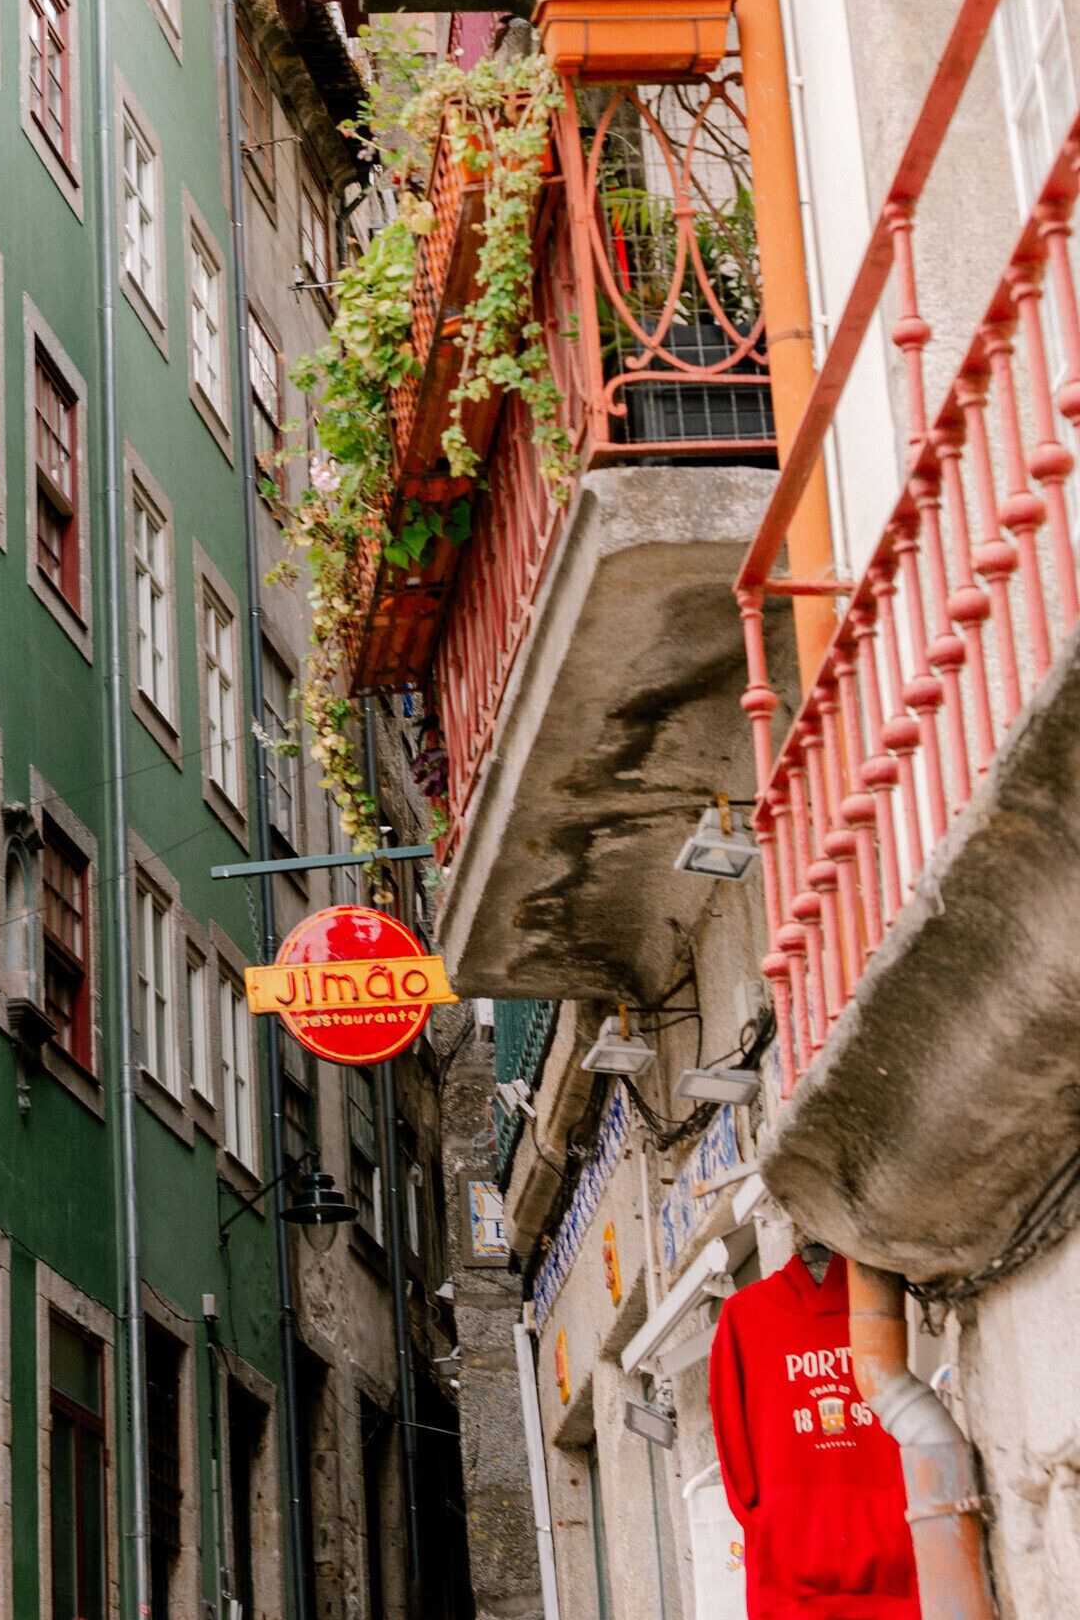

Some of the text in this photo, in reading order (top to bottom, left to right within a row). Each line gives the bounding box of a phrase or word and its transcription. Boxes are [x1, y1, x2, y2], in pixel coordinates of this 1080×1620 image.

[276, 963, 427, 1003] Jimão
[786, 1347, 851, 1380] PORT
[793, 1402, 873, 1433] 18 95
